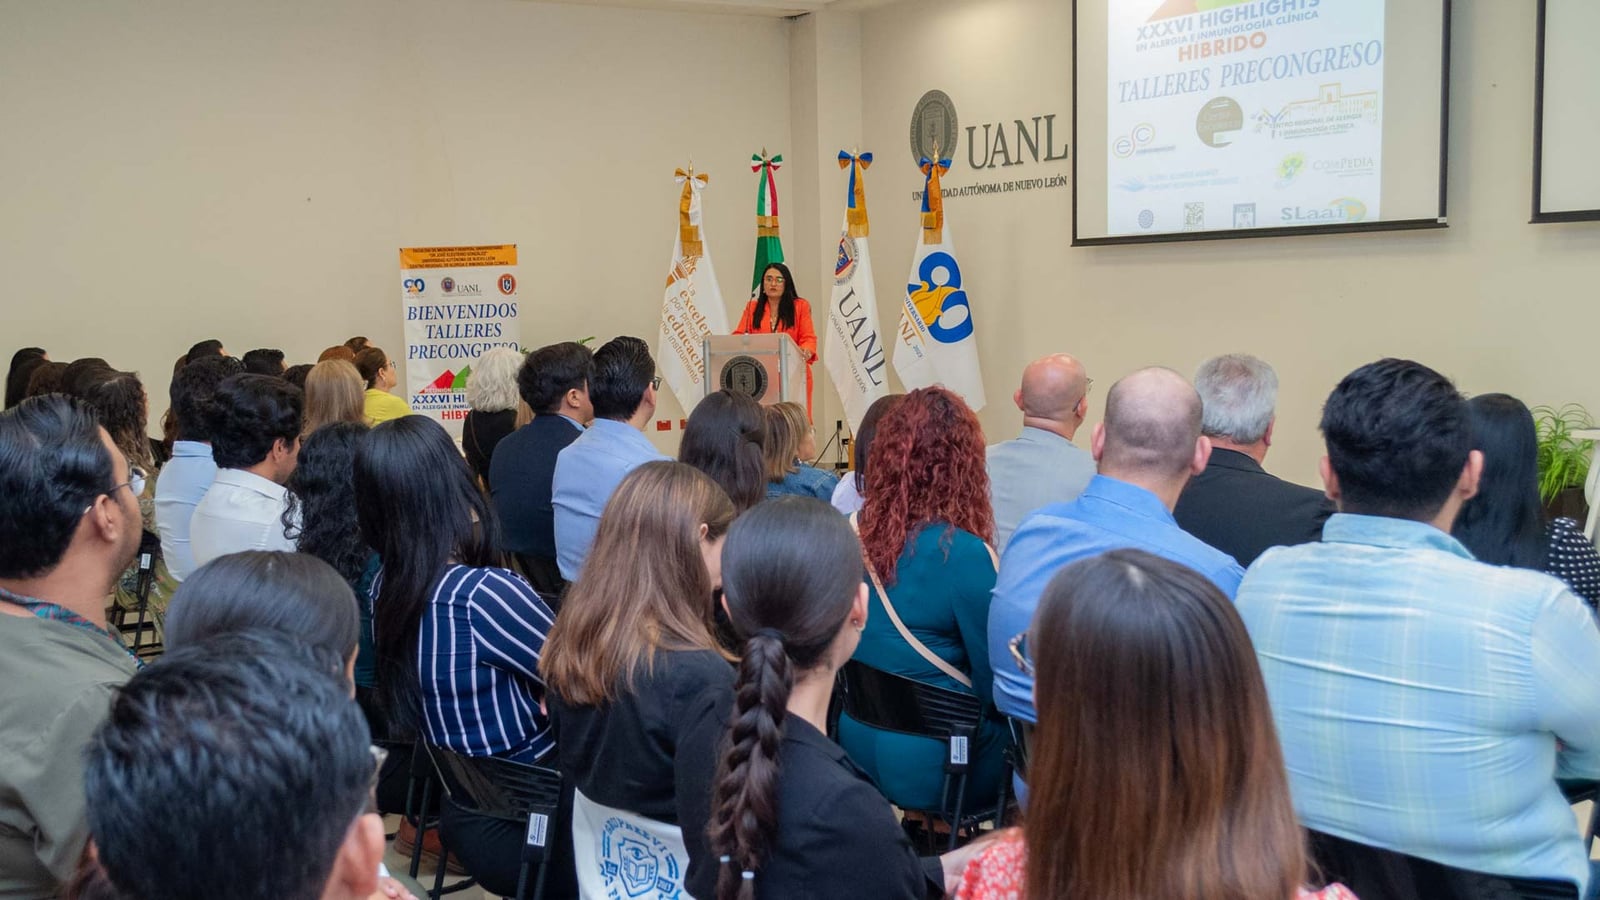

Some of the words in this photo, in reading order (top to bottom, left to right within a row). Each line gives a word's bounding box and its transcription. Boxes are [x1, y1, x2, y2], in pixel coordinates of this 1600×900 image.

[1136, 17, 1193, 41] XXXVI
[1150, 35, 1188, 49] ALERGIA
[1119, 67, 1211, 103] TALLERES
[1220, 40, 1382, 88] PRECONGRESO
[966, 114, 1068, 170] UANL
[911, 187, 958, 201] UNIDAD
[959, 182, 1002, 197] AUTÓNOMA
[1003, 181, 1014, 192] DE
[1015, 178, 1043, 191] NUEVO
[1044, 173, 1068, 188] LEÓN
[457, 283, 482, 293] UANL
[407, 302, 517, 321] BIENVENIDOS
[670, 296, 684, 312] por
[679, 289, 713, 338] excelen
[905, 296, 926, 333] NIVERSARIO
[425, 322, 502, 339] TALLERES
[838, 286, 886, 387] UANL
[899, 313, 916, 346] NL
[667, 313, 705, 378] educació
[412, 394, 450, 404] XXXVI
[441, 410, 470, 420] HIBR
